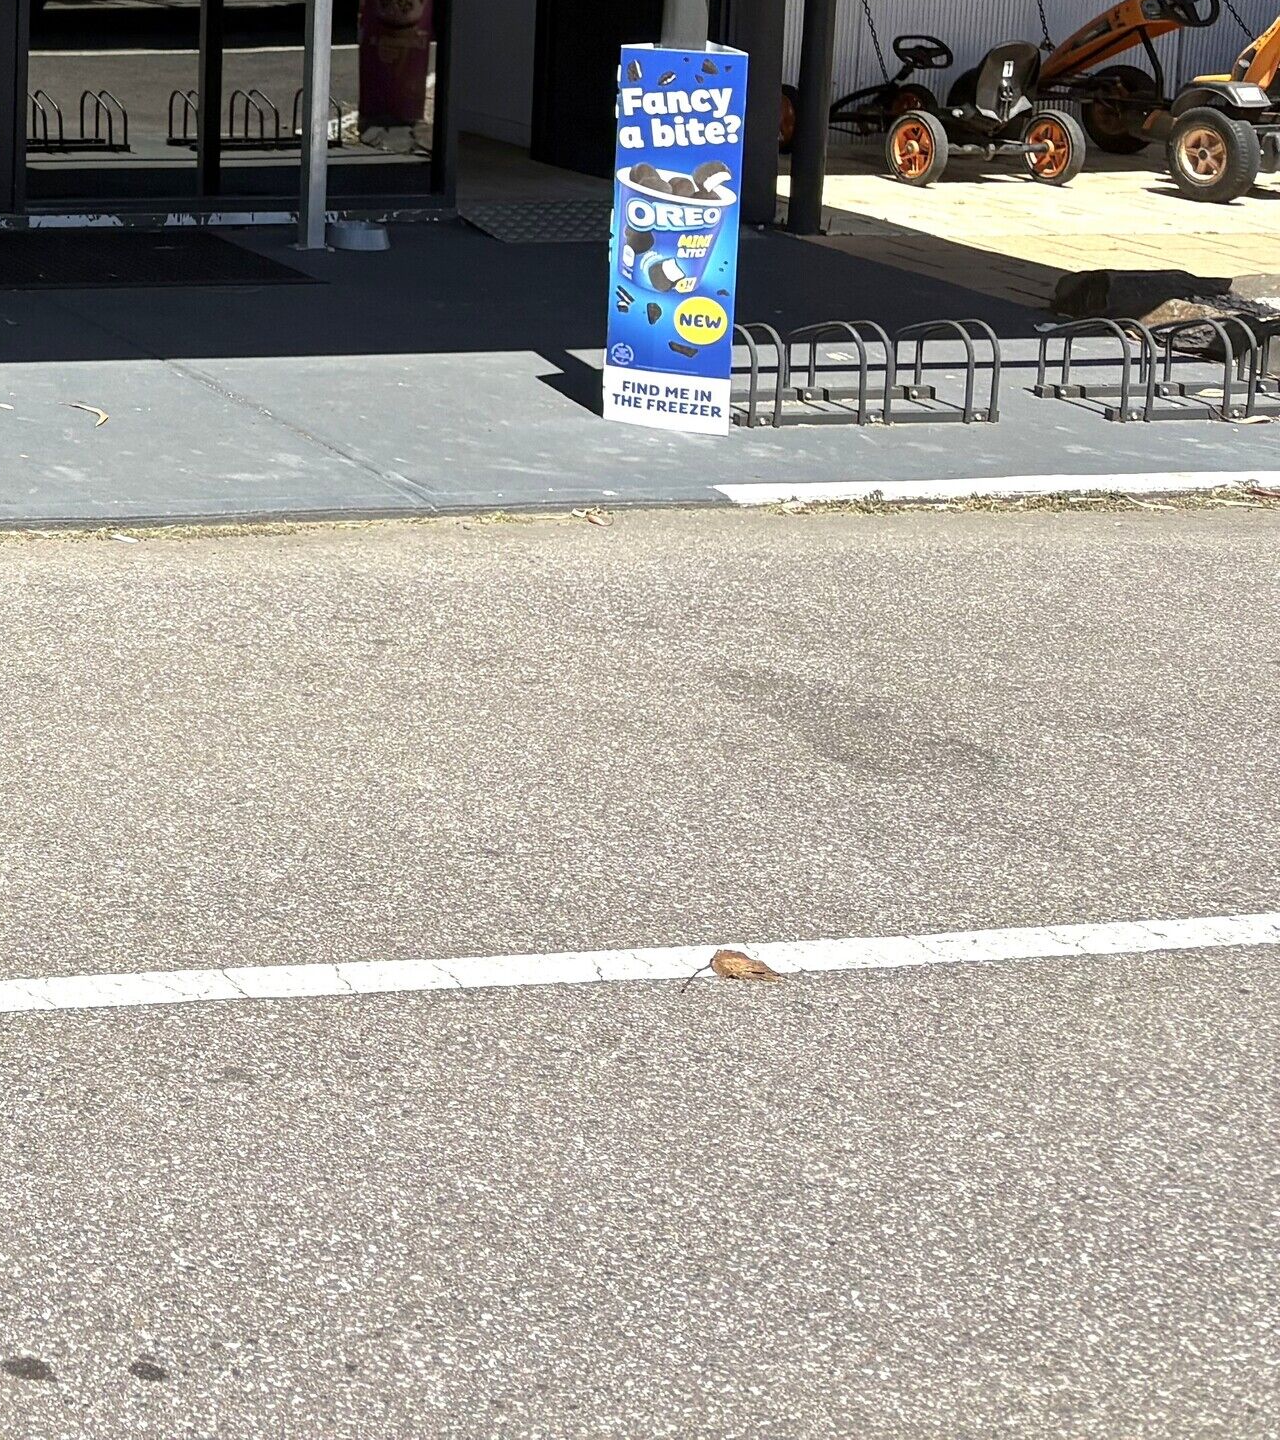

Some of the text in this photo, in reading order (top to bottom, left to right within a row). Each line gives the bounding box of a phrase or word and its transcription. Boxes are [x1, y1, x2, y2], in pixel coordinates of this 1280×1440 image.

[621, 87, 733, 118] Fancy
[619, 115, 741, 149] a bite?
[628, 201, 721, 227] OREO
[680, 313, 721, 329] NEW
[622, 380, 712, 403] FIND ME IN
[613, 392, 723, 419] THE FREEZER
